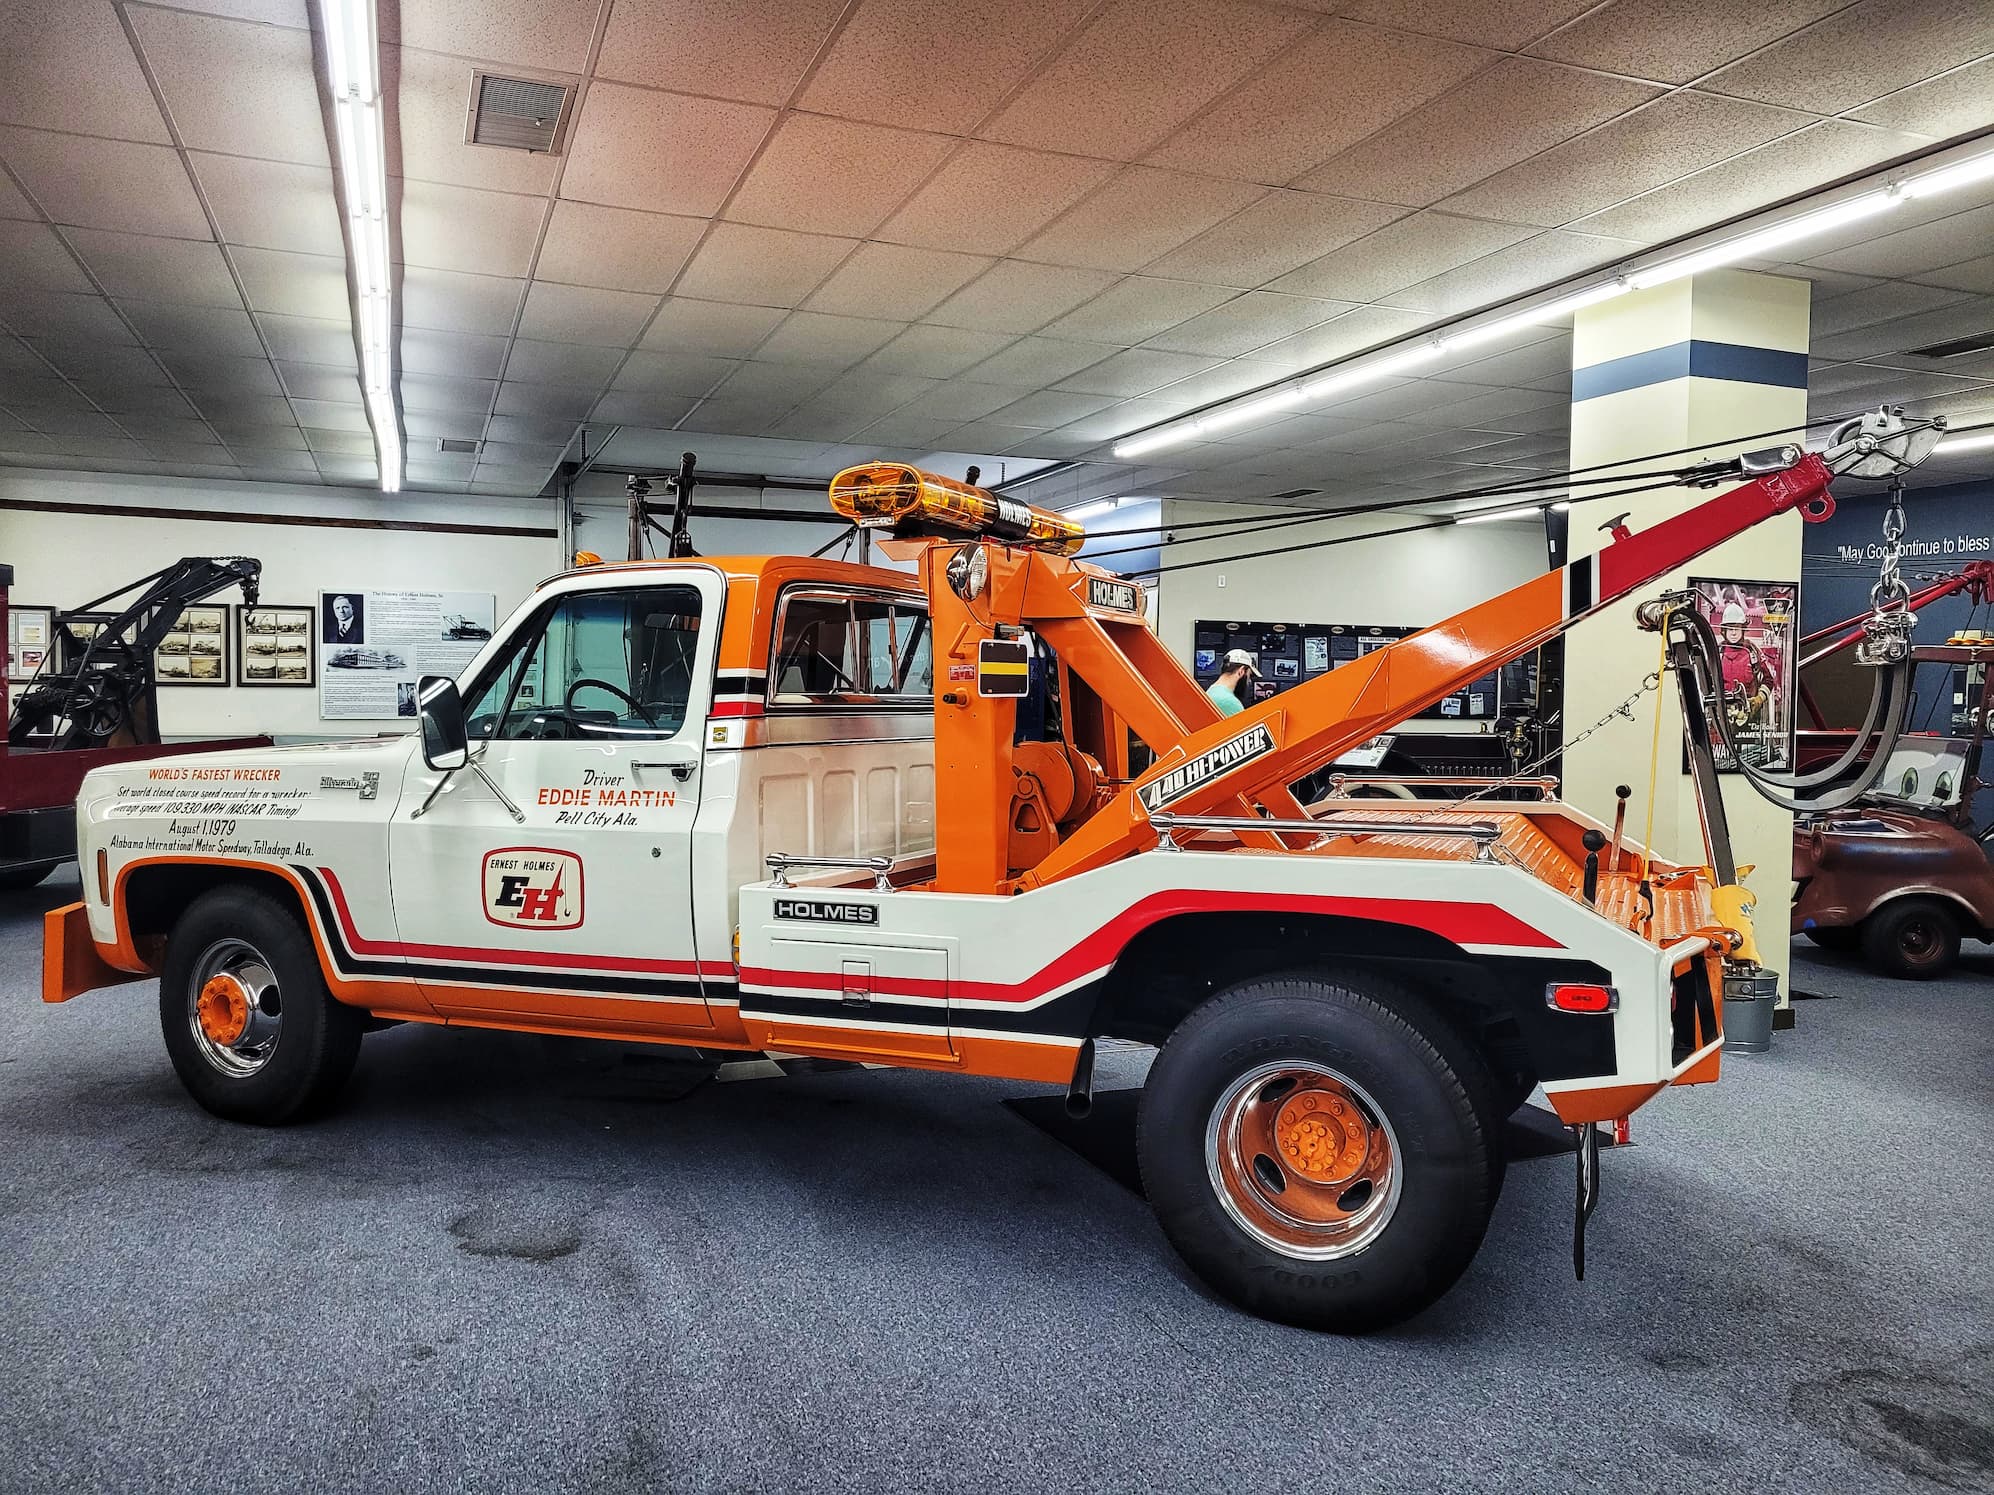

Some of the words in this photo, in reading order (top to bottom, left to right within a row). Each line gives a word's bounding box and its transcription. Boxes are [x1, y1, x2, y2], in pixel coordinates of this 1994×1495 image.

[999, 499, 1032, 528] HOLMES
[1838, 546, 1865, 564] "May
[1893, 537, 1940, 558] ontinue
[1942, 537, 1954, 554] to
[1957, 535, 1990, 552] bless
[1093, 581, 1134, 610] HOLMES
[149, 768, 189, 781] WORLD'S
[191, 768, 231, 781] FASTEST
[233, 769, 281, 781] WRECKER
[1147, 769, 1185, 809] 440
[1185, 727, 1267, 784] HI-POWER
[583, 769, 624, 787] Driver
[117, 785, 131, 798] Set
[131, 786, 152, 797] world
[152, 786, 176, 797] closed
[175, 789, 199, 798] course
[200, 787, 222, 800] speed
[221, 787, 248, 799] record
[248, 787, 262, 799] for
[262, 791, 270, 799] a
[537, 788, 591, 806] EDDIE
[598, 790, 676, 808] MARTIN
[200, 803, 228, 815] MPH
[266, 803, 303, 819] Timing)
[555, 811, 583, 825] Pell
[583, 811, 612, 828] City
[612, 812, 639, 827] Ala.
[168, 819, 201, 838] August
[110, 834, 144, 849] Alabama
[145, 836, 194, 852] International
[194, 837, 216, 853] Motor
[294, 841, 315, 857] Ala.
[490, 859, 518, 870] ERNEST
[523, 860, 556, 872] HOLMES
[778, 902, 873, 921] HOLMES
